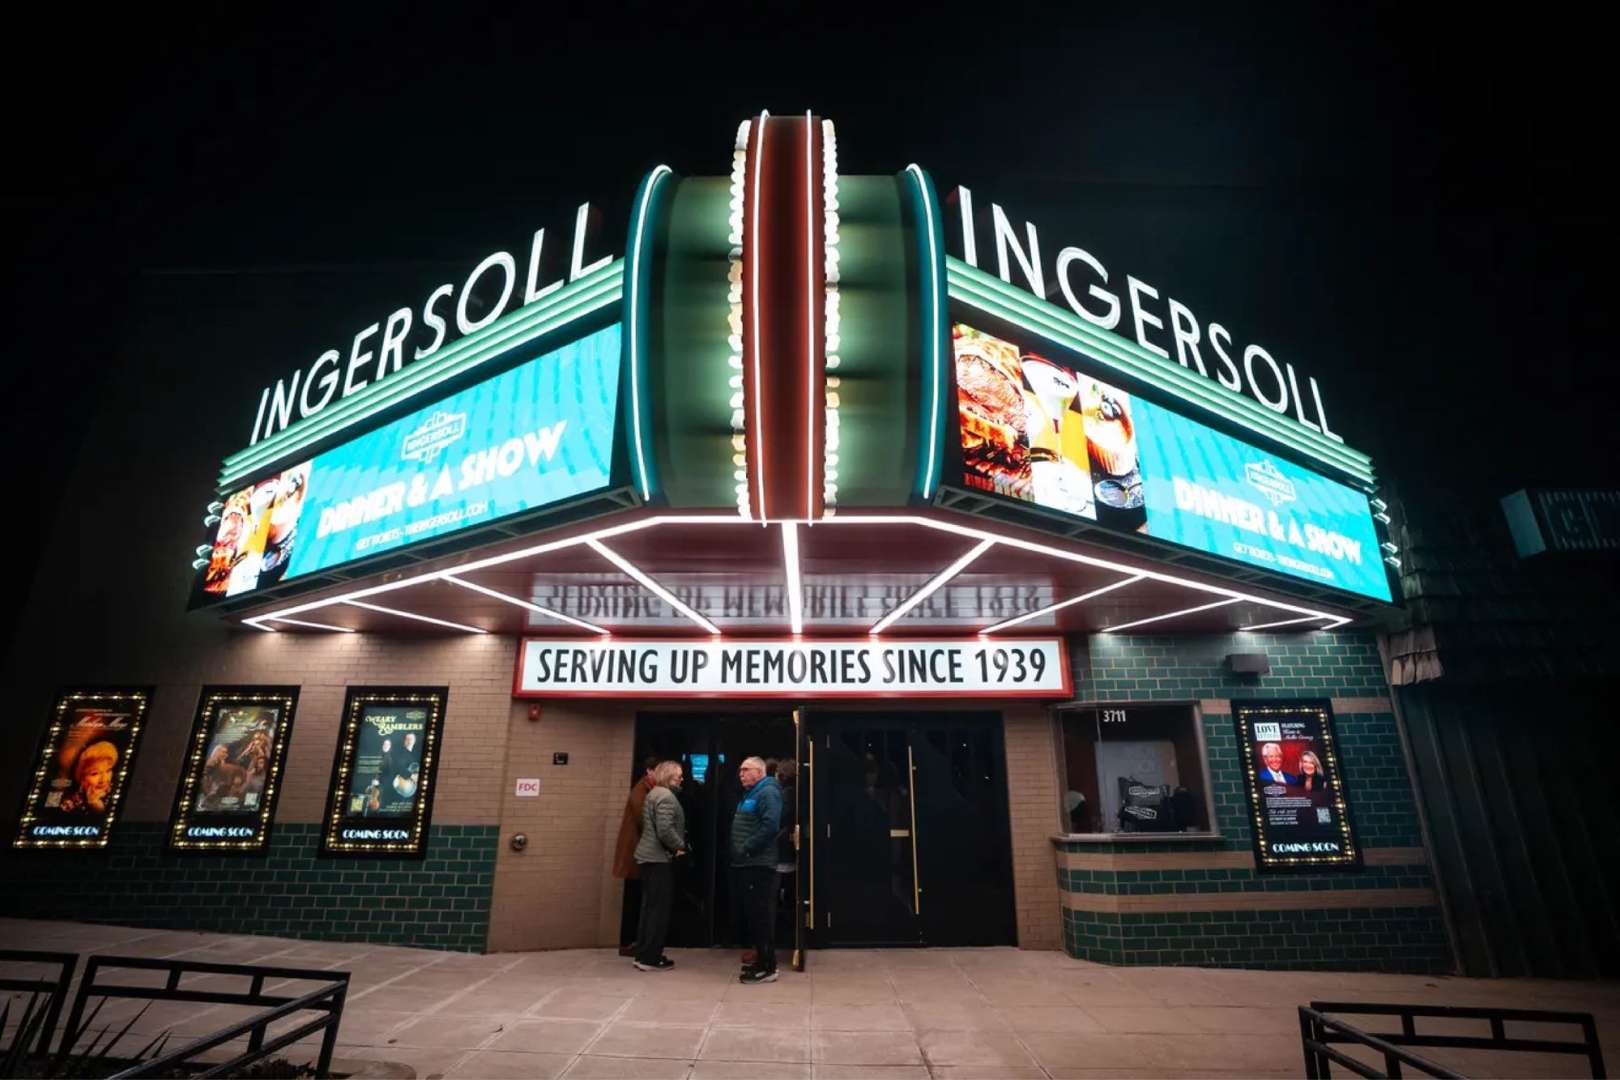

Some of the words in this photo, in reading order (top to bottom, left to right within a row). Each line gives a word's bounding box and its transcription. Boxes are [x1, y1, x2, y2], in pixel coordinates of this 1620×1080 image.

[955, 184, 1344, 443] INGERSOLL
[250, 201, 614, 446] INGERSOLL
[316, 480, 406, 538] DINNER
[408, 473, 429, 506] &
[431, 464, 453, 498] A
[458, 420, 567, 490] SHOW
[1174, 476, 1267, 536] DINNER
[1268, 511, 1286, 543] &
[1288, 518, 1304, 548] A
[1304, 523, 1361, 566] SHOW
[537, 648, 659, 685] SERVING
[669, 648, 708, 685] UP
[720, 648, 873, 685] MEMORIES
[881, 648, 965, 684] SINCE
[974, 648, 1048, 682] 1939
[365, 715, 397, 727] WEARY
[1102, 710, 1126, 723] 3711
[378, 722, 424, 736] RAMBLERS
[1256, 725, 1279, 734] LOVE
[517, 782, 537, 793] FDC
[33, 826, 72, 836] COMING
[74, 826, 99, 836] SOON
[188, 826, 225, 838] COMING
[227, 826, 254, 838] SOON
[342, 829, 382, 840] COMING
[382, 829, 409, 840] SOON
[1272, 842, 1312, 854] COMING
[1312, 842, 1340, 853] SOON
